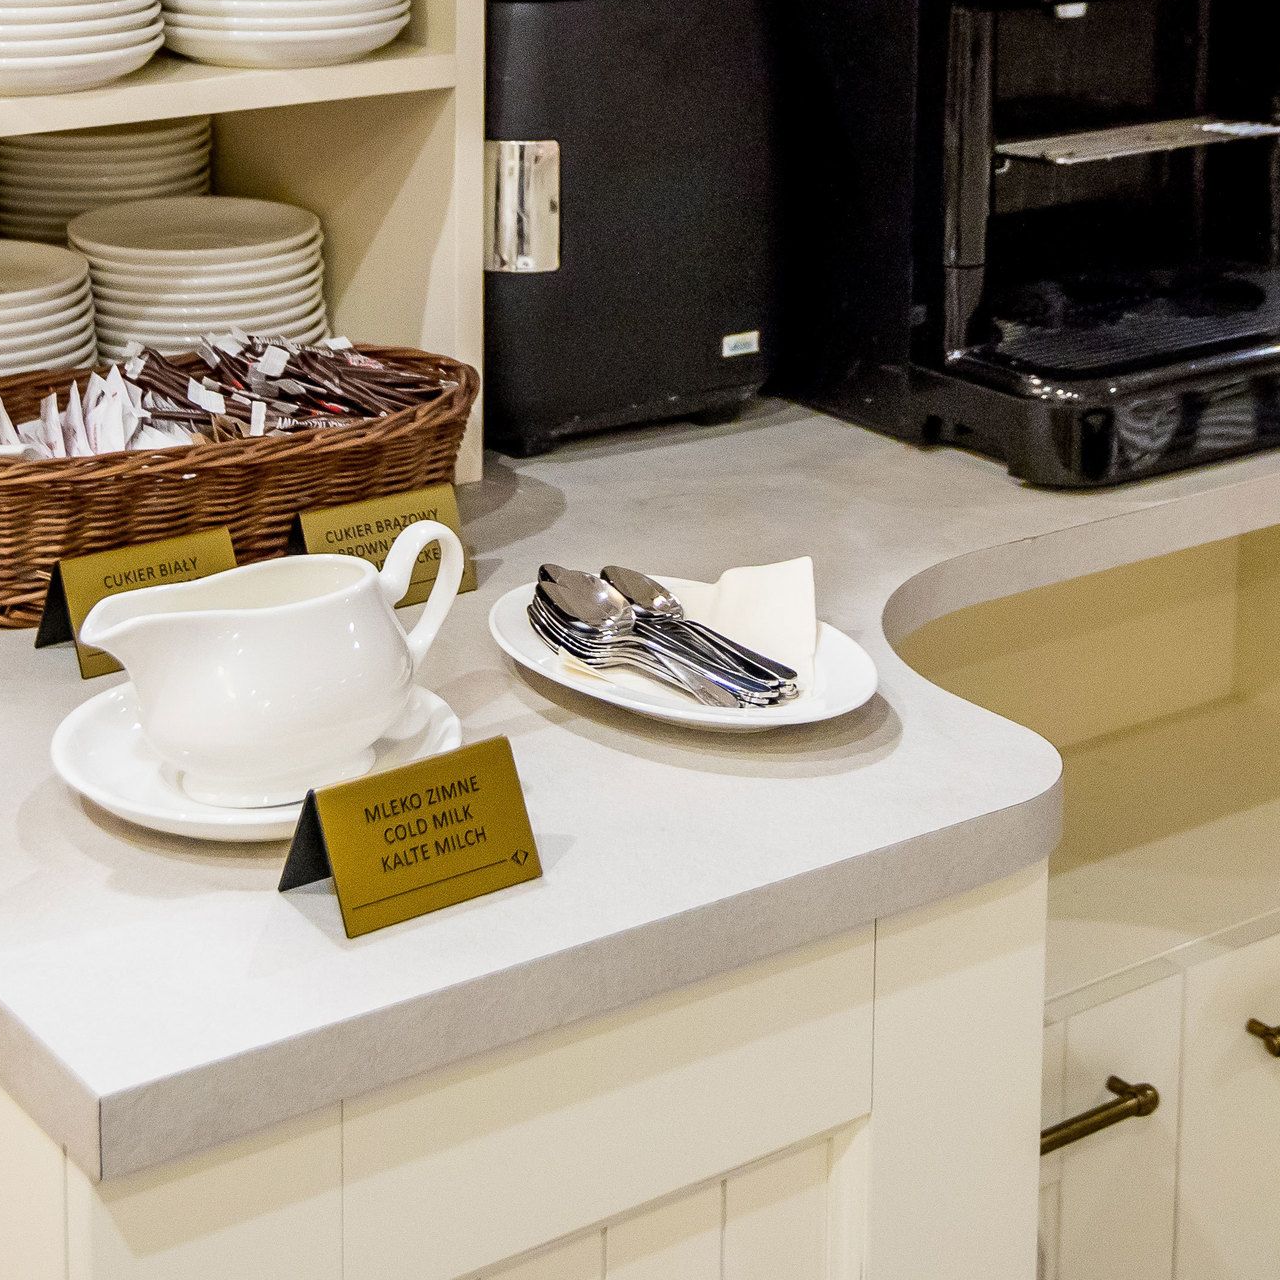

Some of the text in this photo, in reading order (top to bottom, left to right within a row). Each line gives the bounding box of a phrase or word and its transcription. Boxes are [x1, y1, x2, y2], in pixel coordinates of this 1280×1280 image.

[324, 523, 373, 544] CUKIER
[103, 557, 198, 589] CUKIER BIAŁY
[364, 775, 480, 823] MLEKO ZIMNE
[384, 803, 474, 845] COLD MILK
[381, 826, 487, 873] KALTE MILCH
